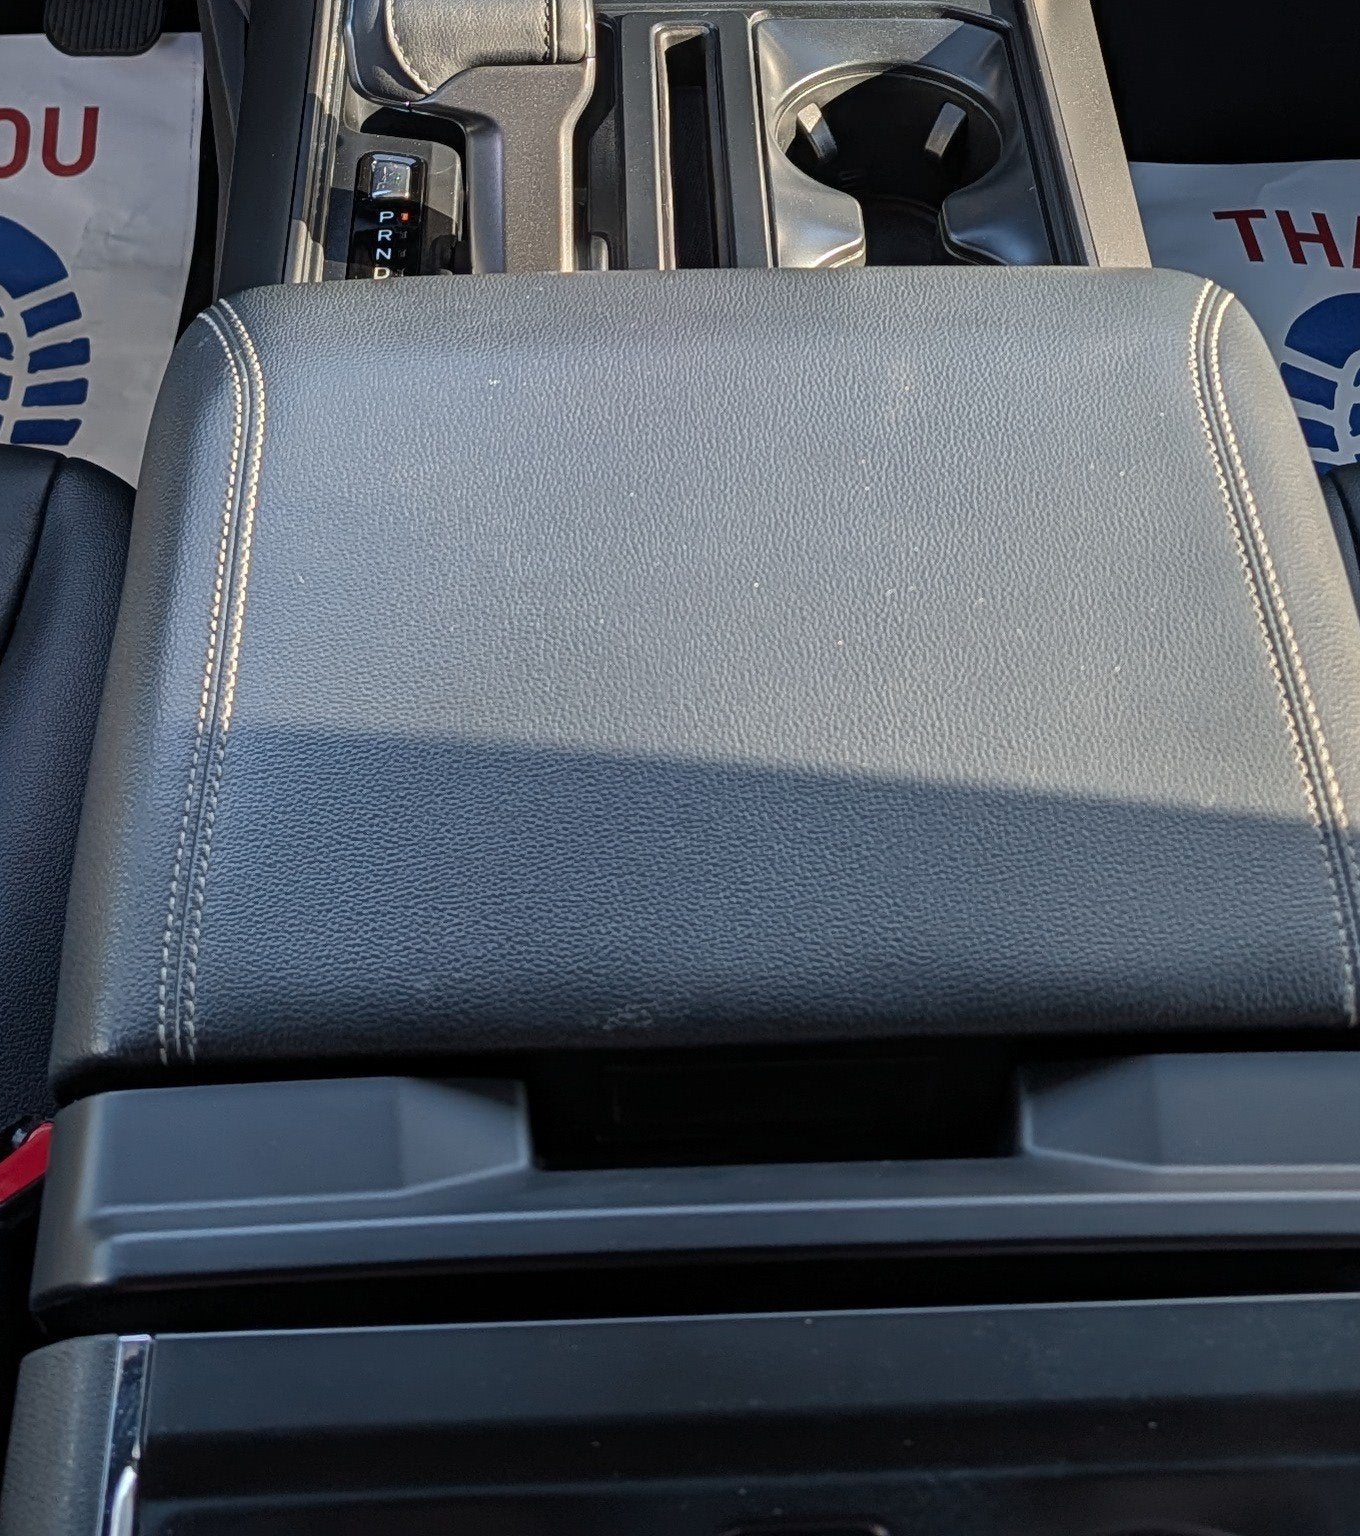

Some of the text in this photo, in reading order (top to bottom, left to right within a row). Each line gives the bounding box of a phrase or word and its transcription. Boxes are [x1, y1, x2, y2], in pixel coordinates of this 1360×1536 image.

[379, 211, 395, 223] P
[377, 229, 393, 242] R
[375, 247, 392, 260] N
[373, 266, 391, 280] D
